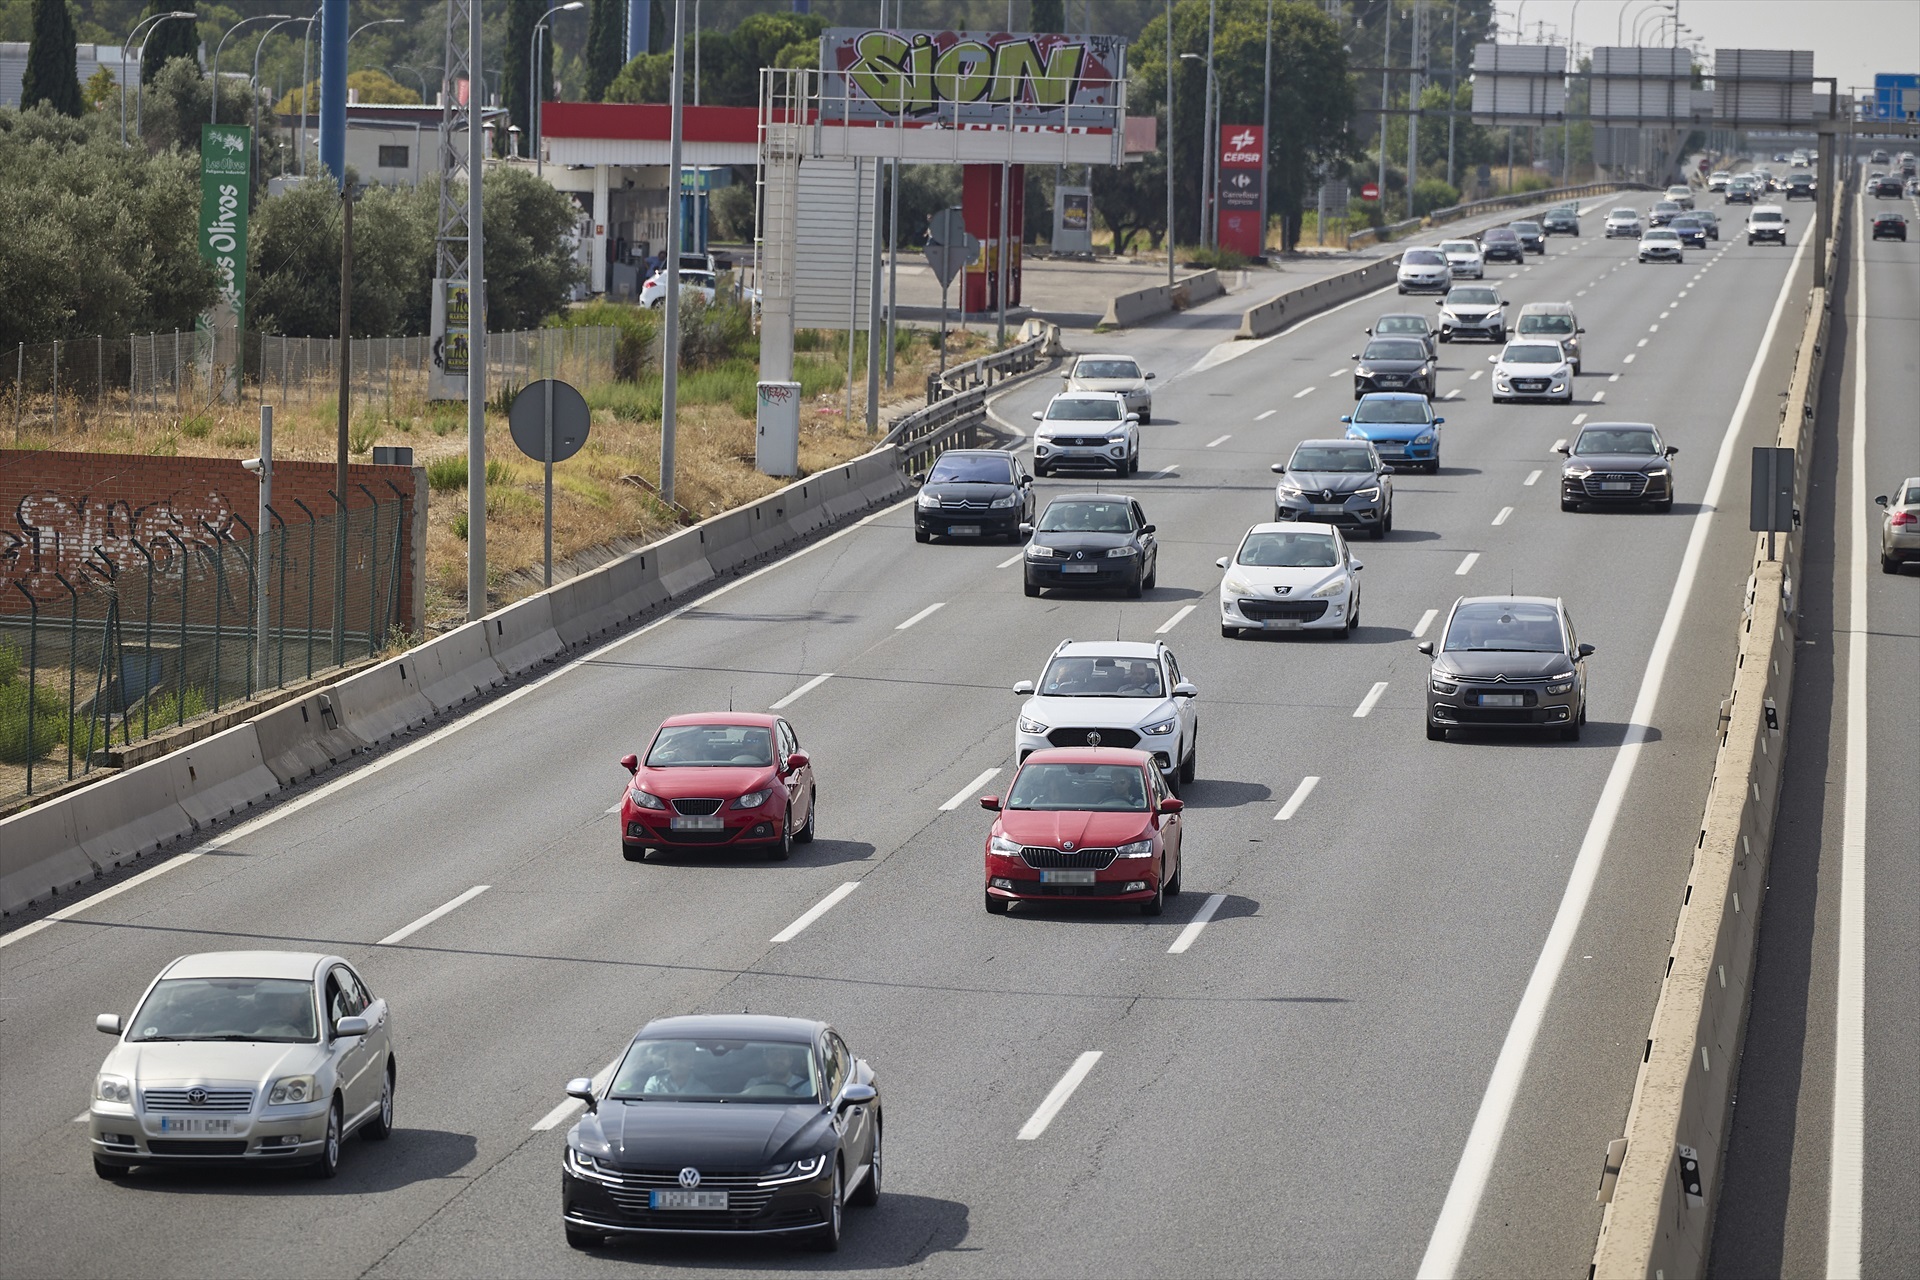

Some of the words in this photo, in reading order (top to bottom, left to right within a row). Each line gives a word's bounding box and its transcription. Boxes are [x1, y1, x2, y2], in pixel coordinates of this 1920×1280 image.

[206, 158, 220, 169] Los
[220, 157, 246, 170] Olivos
[1224, 153, 1260, 162] CEPSA
[1223, 191, 1258, 199] Carrefour
[208, 185, 238, 252] Olivos
[678, 1166, 701, 1188] VW
